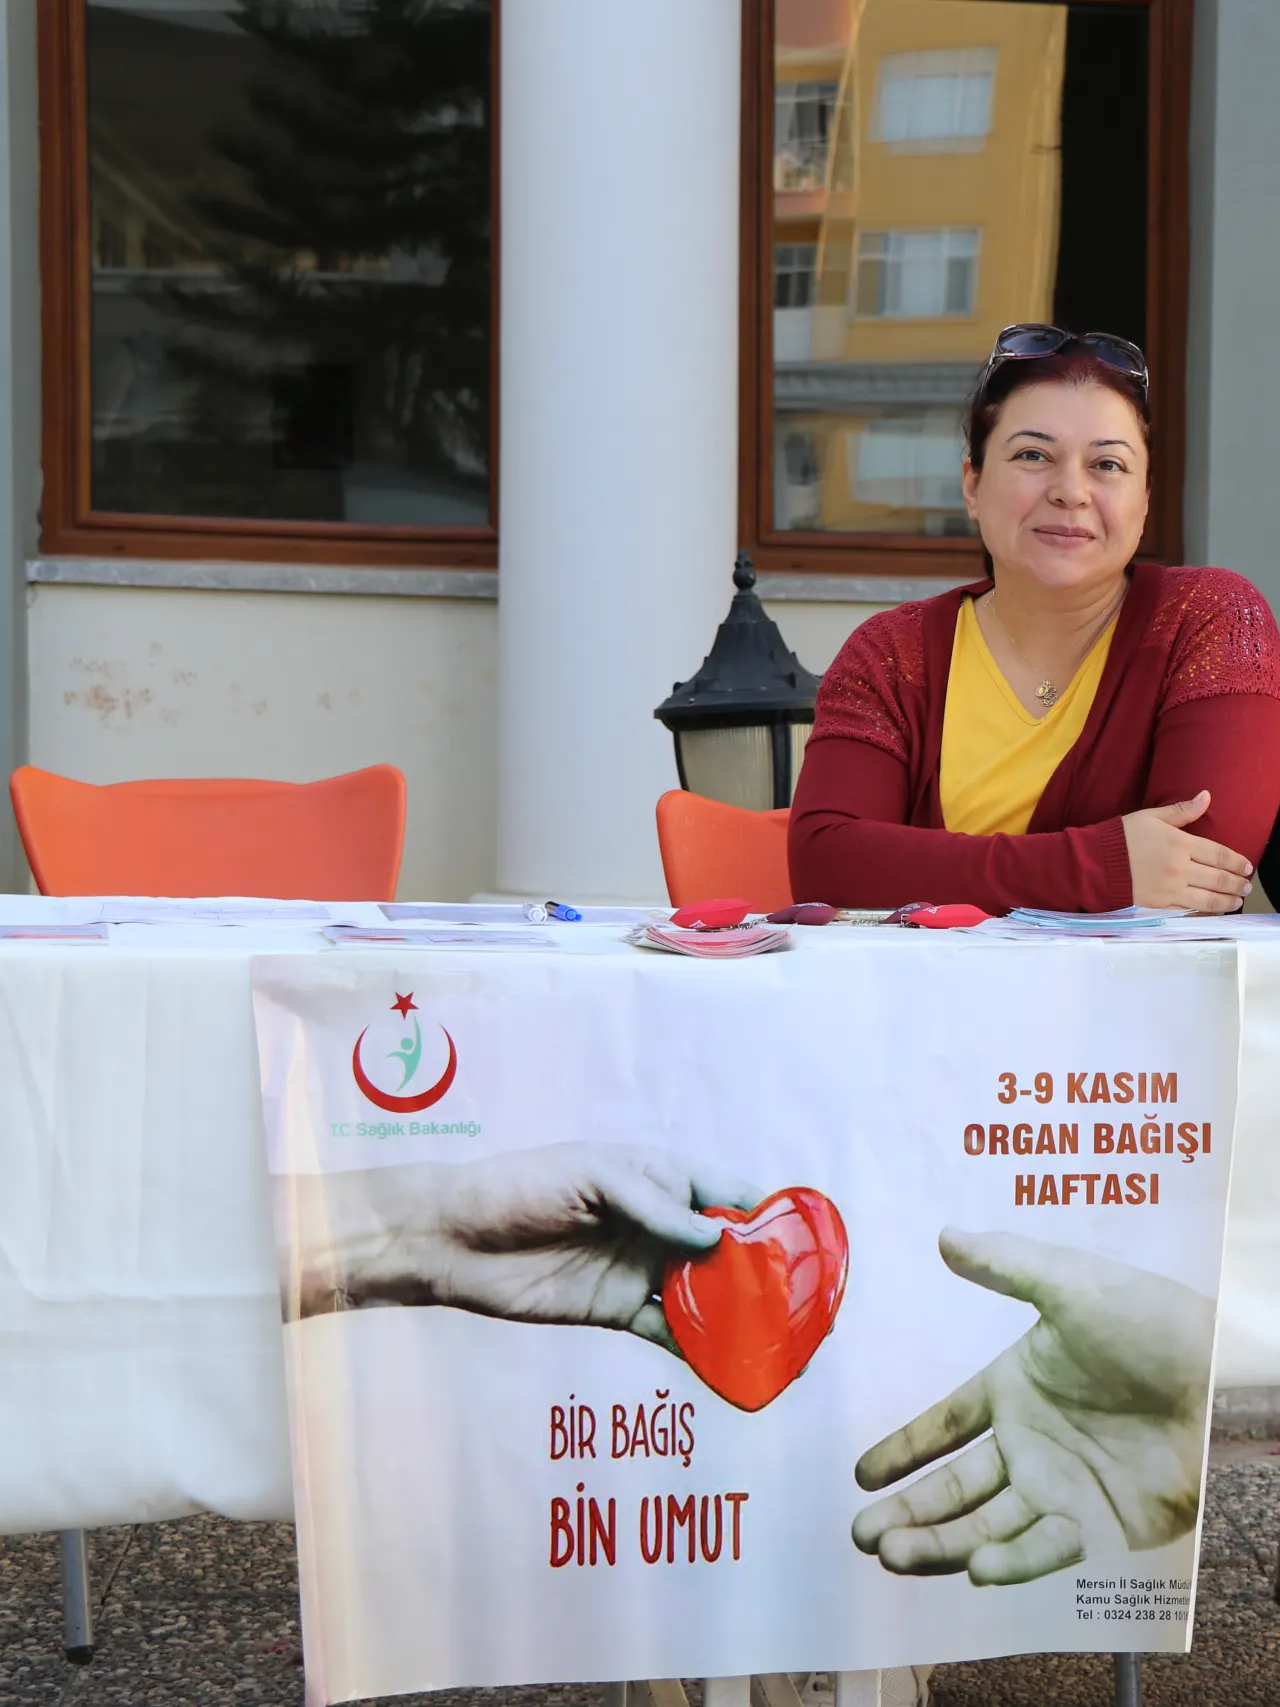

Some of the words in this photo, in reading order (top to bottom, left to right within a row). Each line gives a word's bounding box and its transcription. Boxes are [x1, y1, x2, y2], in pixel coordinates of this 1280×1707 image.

[997, 1072, 1054, 1104] 3-9
[1067, 1072, 1178, 1104] KASIM
[356, 1122, 405, 1139] Sağlık
[409, 1120, 481, 1137] Bakanlığı
[964, 1123, 1079, 1155] ORGAN
[1093, 1113, 1211, 1163] BAĞIŞI
[1015, 1173, 1159, 1206] HAFTASI
[550, 1394, 597, 1460] BİR
[611, 1389, 695, 1468] BAĞIŞ
[550, 1482, 616, 1568] BİN
[640, 1493, 749, 1564] UMUT
[1076, 1579, 1116, 1589] Mersin
[1119, 1577, 1126, 1589] İl
[1130, 1579, 1166, 1591] Sağlık
[1076, 1594, 1110, 1605] Kamu
[1114, 1594, 1151, 1607] Sağlık
[1076, 1610, 1093, 1620] Tel
[1104, 1610, 1131, 1620] 0324
[1135, 1610, 1155, 1620] 238
[1159, 1610, 1171, 1620] 28
